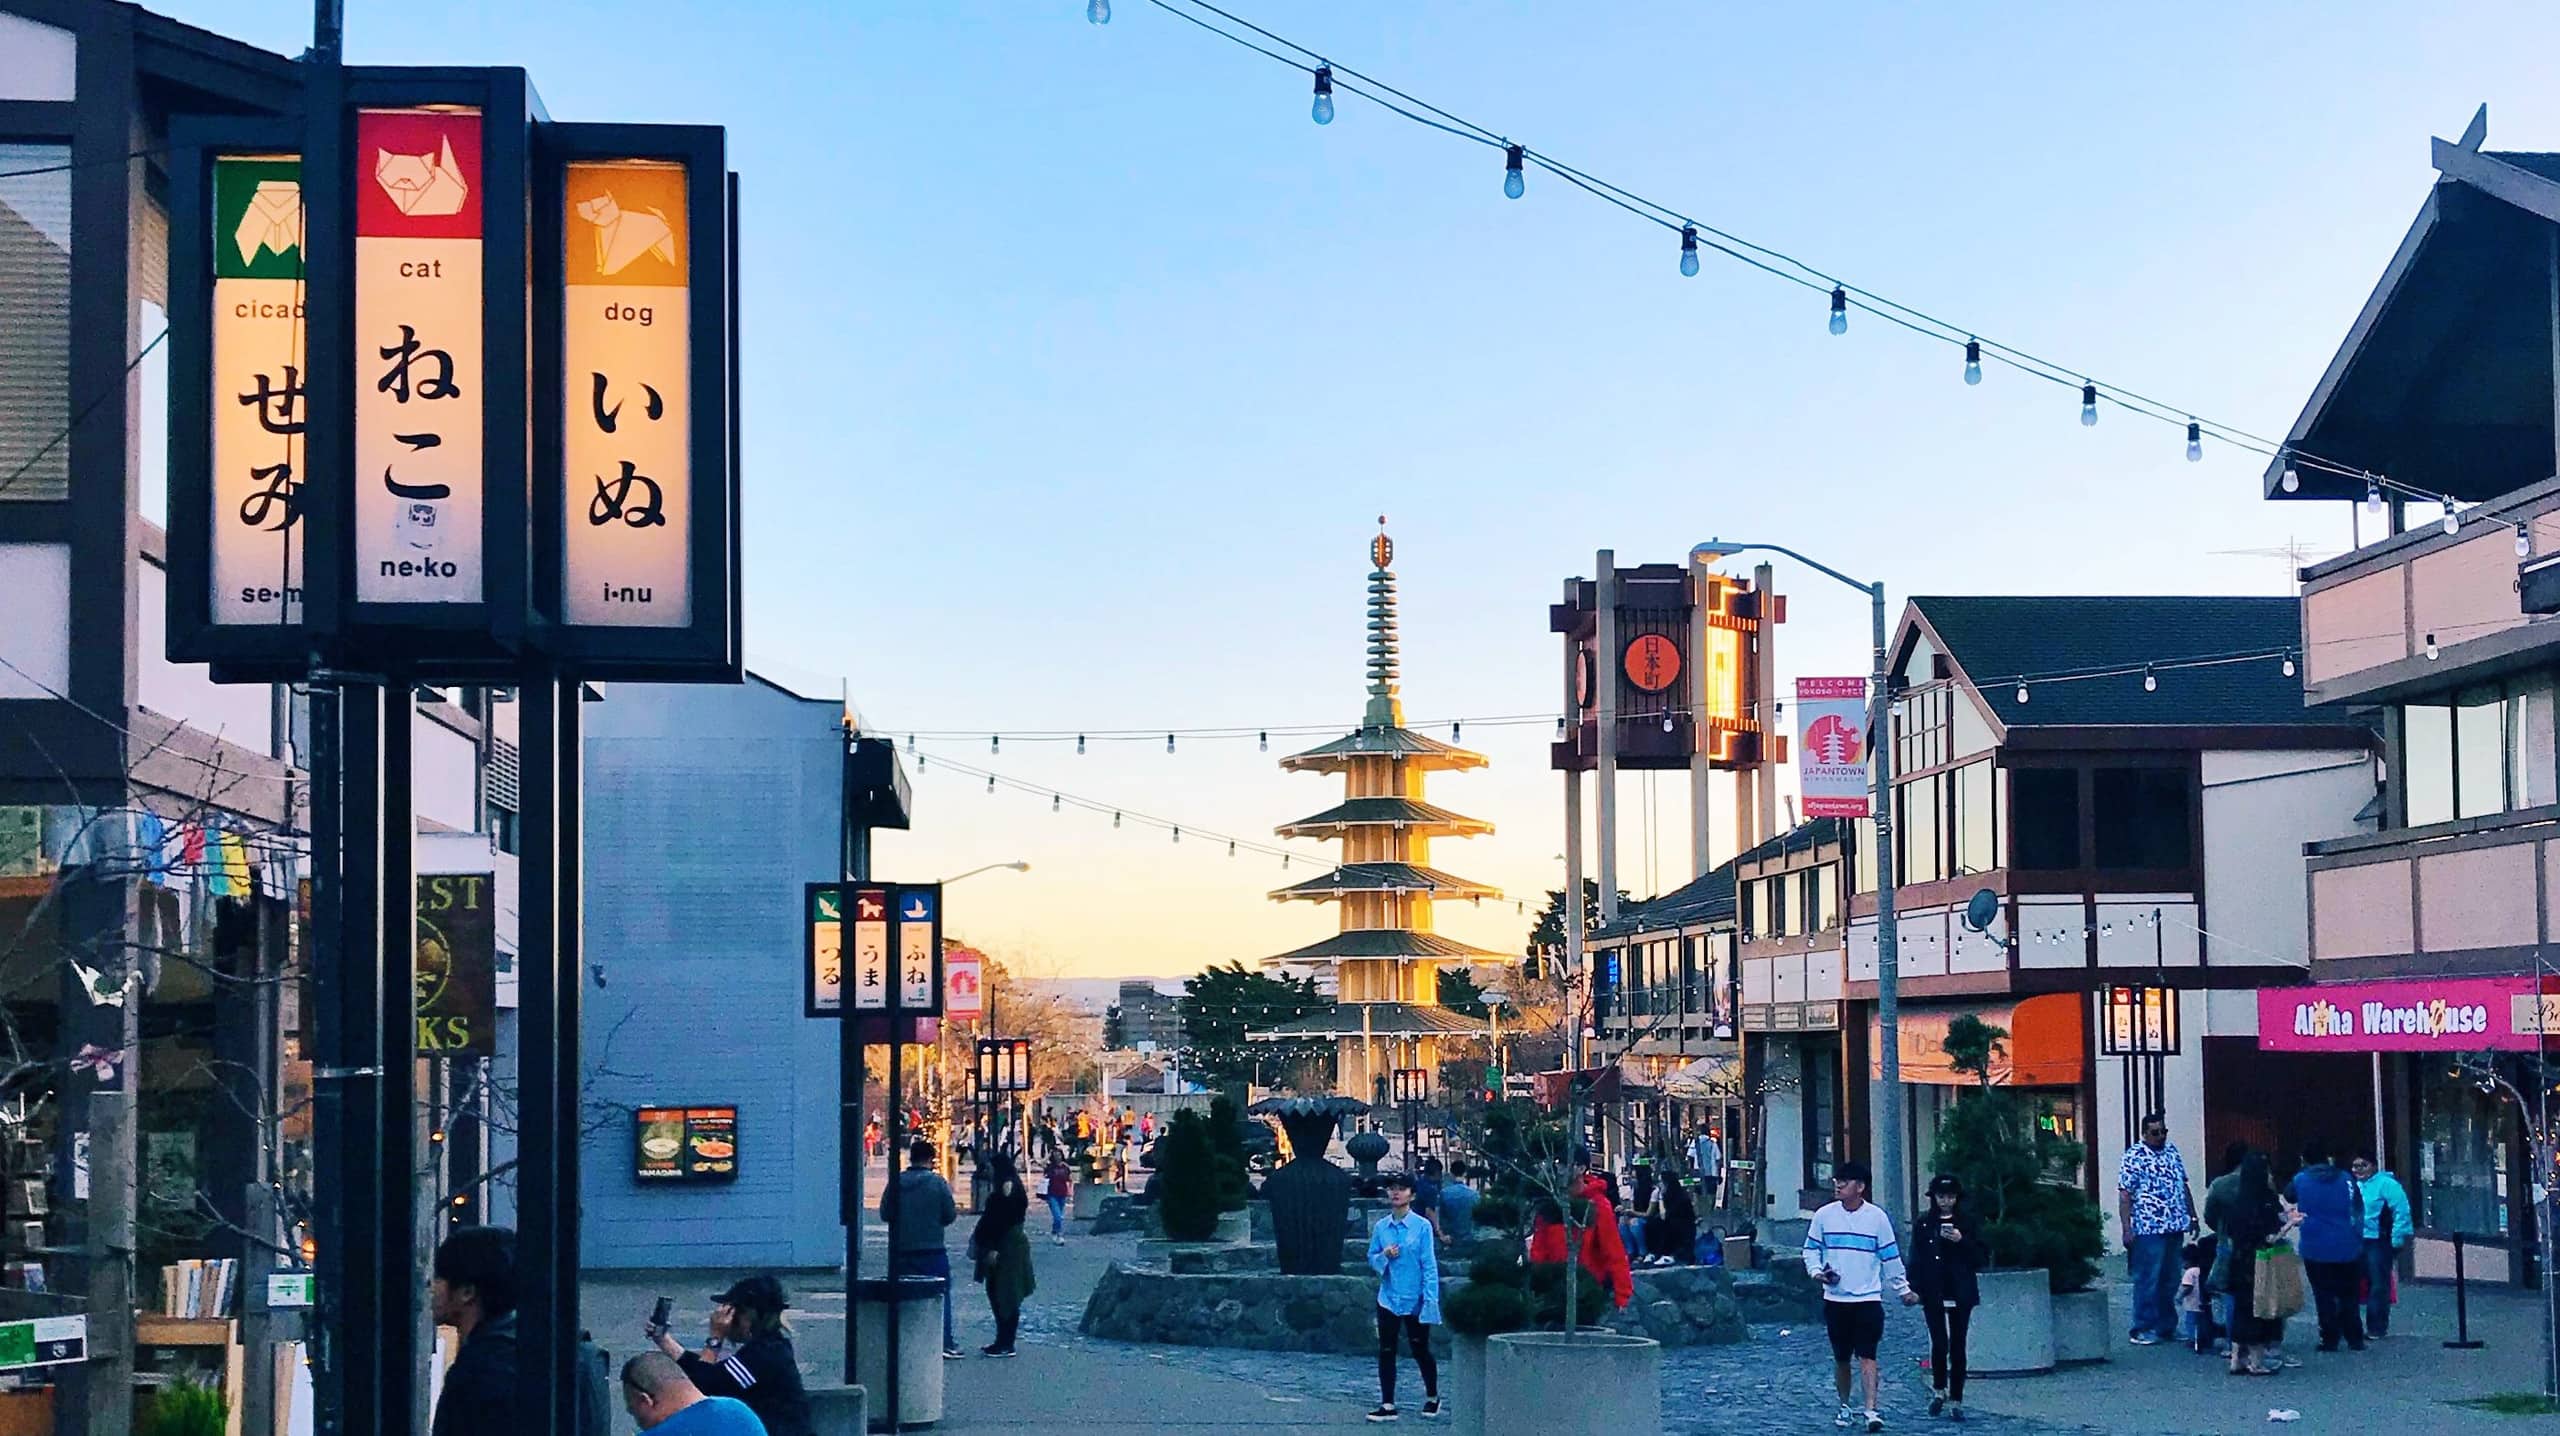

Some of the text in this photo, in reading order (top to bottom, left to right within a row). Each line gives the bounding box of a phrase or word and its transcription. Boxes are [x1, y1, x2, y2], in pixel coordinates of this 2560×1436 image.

[400, 259, 441, 278] cat
[604, 302, 653, 326] dog
[377, 324, 461, 501] ねこ
[237, 365, 305, 532] せみ
[589, 371, 666, 528] いぬ
[1644, 636, 1661, 689] 日本町
[1797, 679, 1865, 688] WELCOME
[1803, 766, 1866, 777] JAPANTOWN
[862, 944, 880, 988] うま
[906, 943, 927, 985] ふね
[2294, 999, 2487, 1039] Aloha Warehouse
